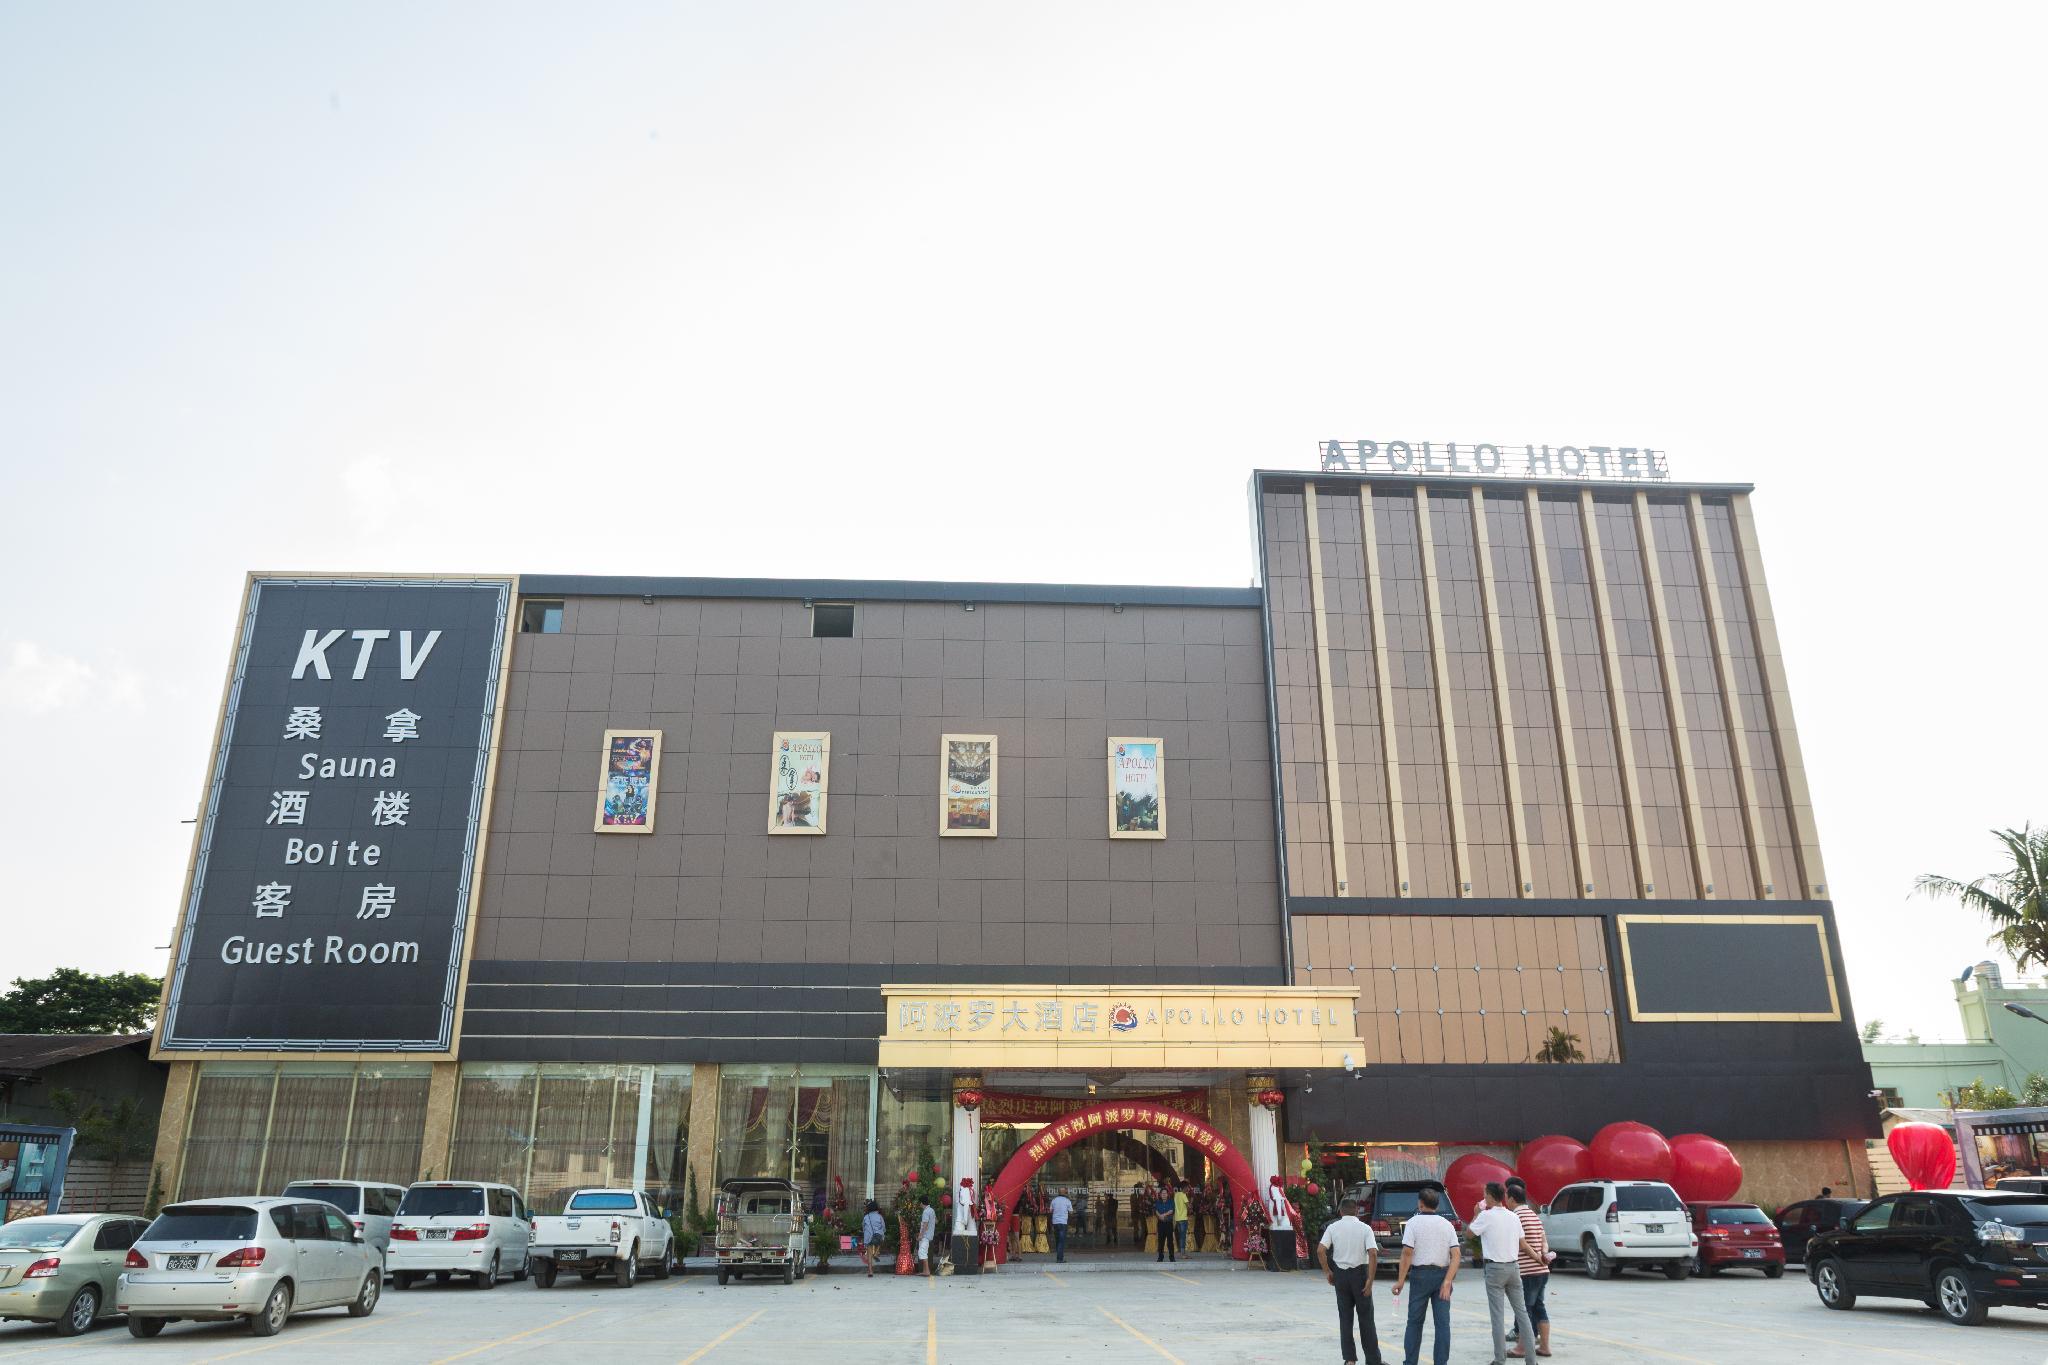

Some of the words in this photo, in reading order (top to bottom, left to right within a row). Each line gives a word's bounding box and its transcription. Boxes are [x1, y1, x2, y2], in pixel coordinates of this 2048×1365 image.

[1323, 440, 1500, 473] APOLLO
[1526, 444, 1666, 478] HOTEL
[291, 629, 442, 680] KTV
[284, 706, 422, 743] 桑拿
[299, 752, 396, 780] Sauna
[266, 790, 410, 827] 酒楼
[285, 838, 382, 866] Boite
[252, 881, 397, 919] 客房
[221, 936, 315, 965] Guest
[324, 936, 420, 964] Room
[899, 1000, 1099, 1033] 阿波罗大酒店
[1145, 1008, 1246, 1026] APOLLO
[1257, 1007, 1337, 1026] HOTEL
[1028, 1108, 1227, 1162] 热烈庆祝阿波罗大酒店试营业
